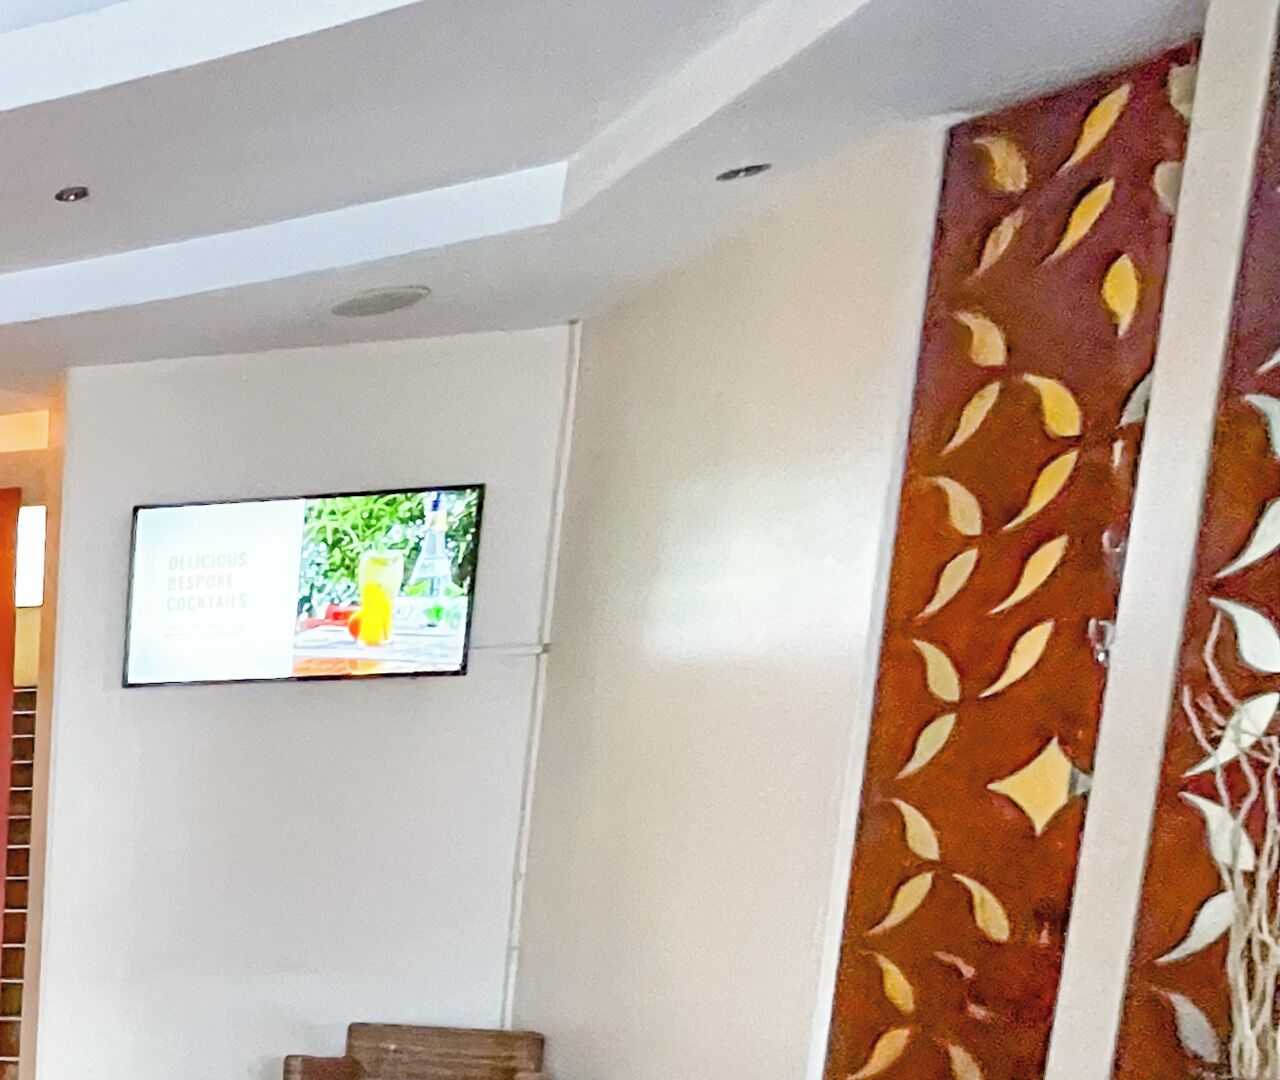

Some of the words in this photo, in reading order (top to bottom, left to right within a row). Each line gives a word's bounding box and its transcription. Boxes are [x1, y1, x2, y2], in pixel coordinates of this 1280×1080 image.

[168, 551, 247, 571] DELICIOUS
[167, 573, 234, 592] BESPOKE
[165, 593, 248, 612] COCKTAILS
